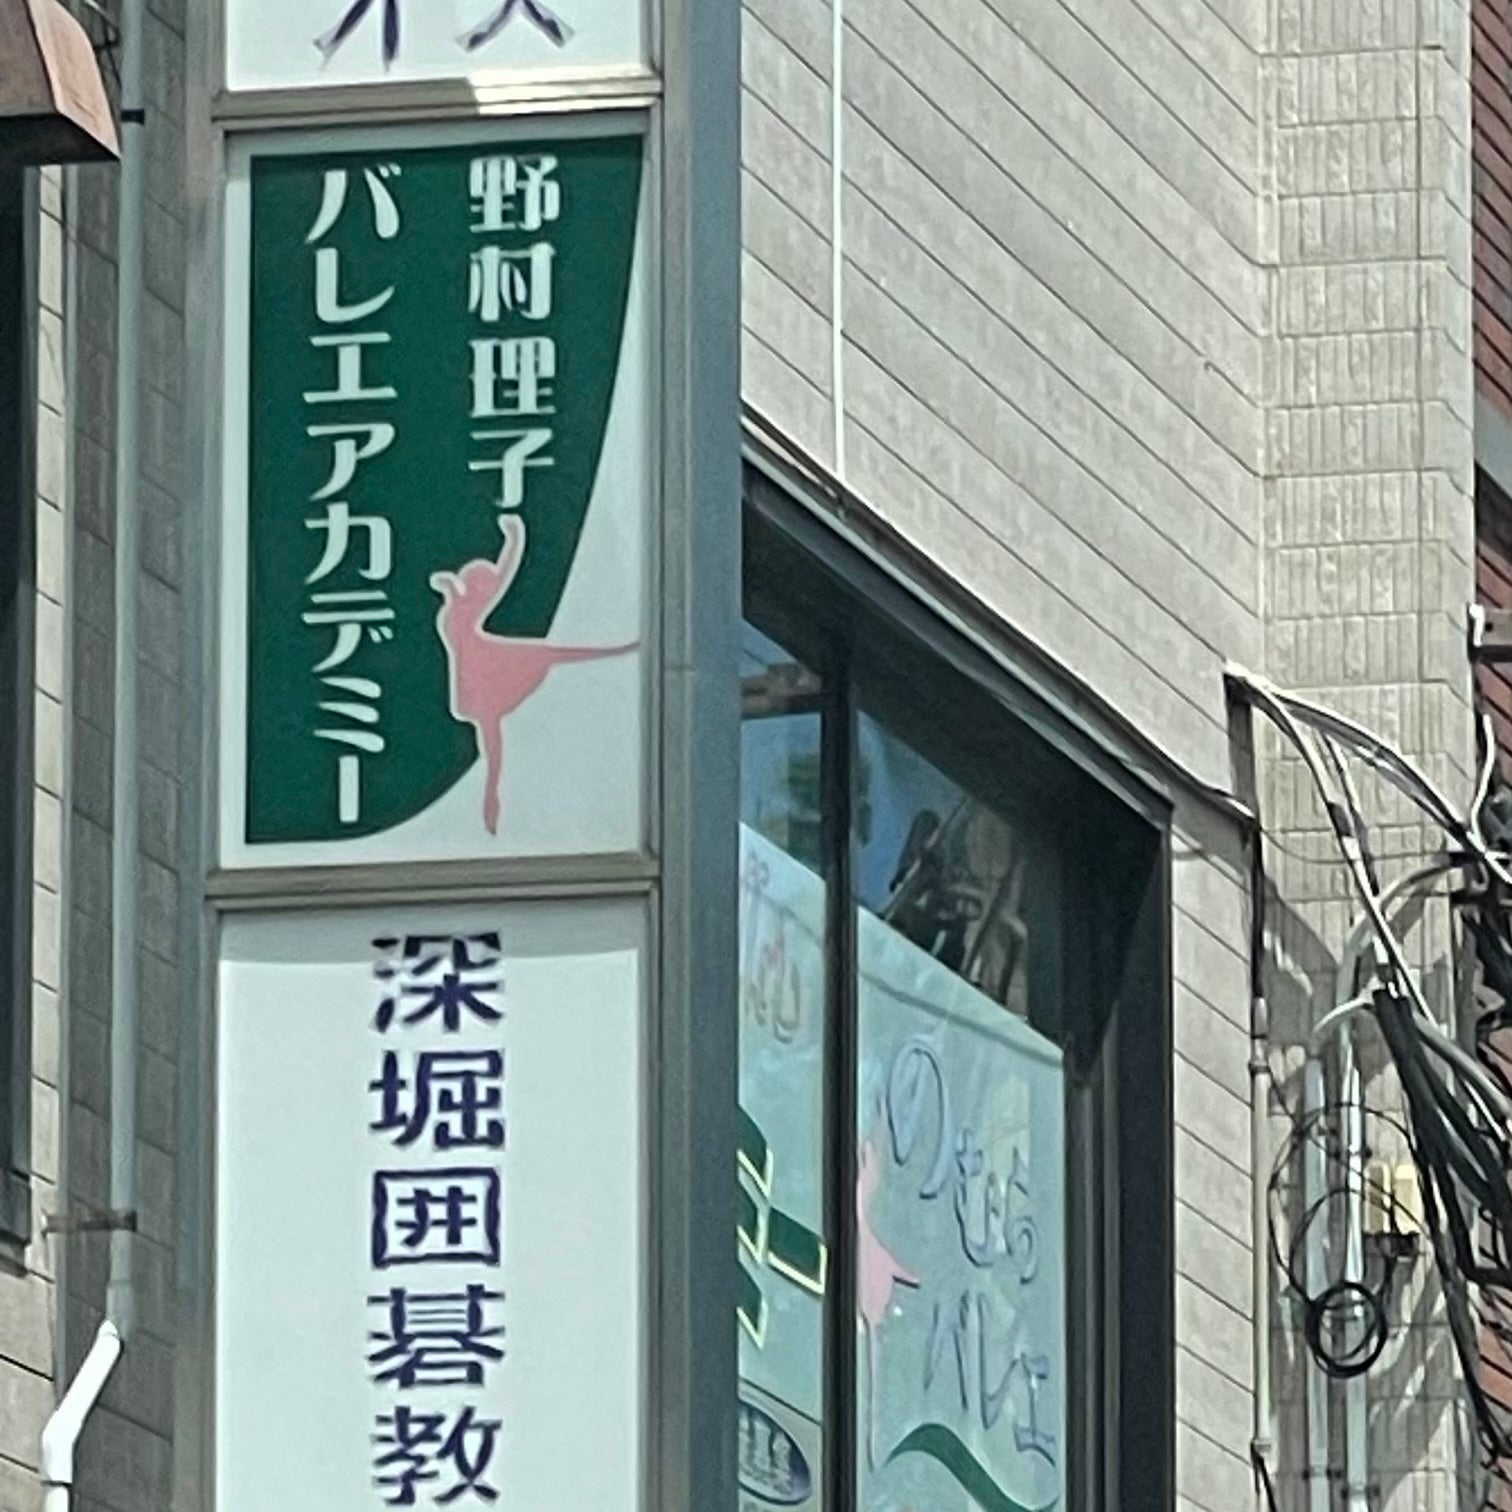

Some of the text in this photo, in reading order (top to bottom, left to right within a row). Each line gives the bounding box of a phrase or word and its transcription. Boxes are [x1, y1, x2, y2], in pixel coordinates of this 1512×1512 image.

[302, 162, 402, 824] バレエアカデミー
[467, 155, 561, 509] 野村理子
